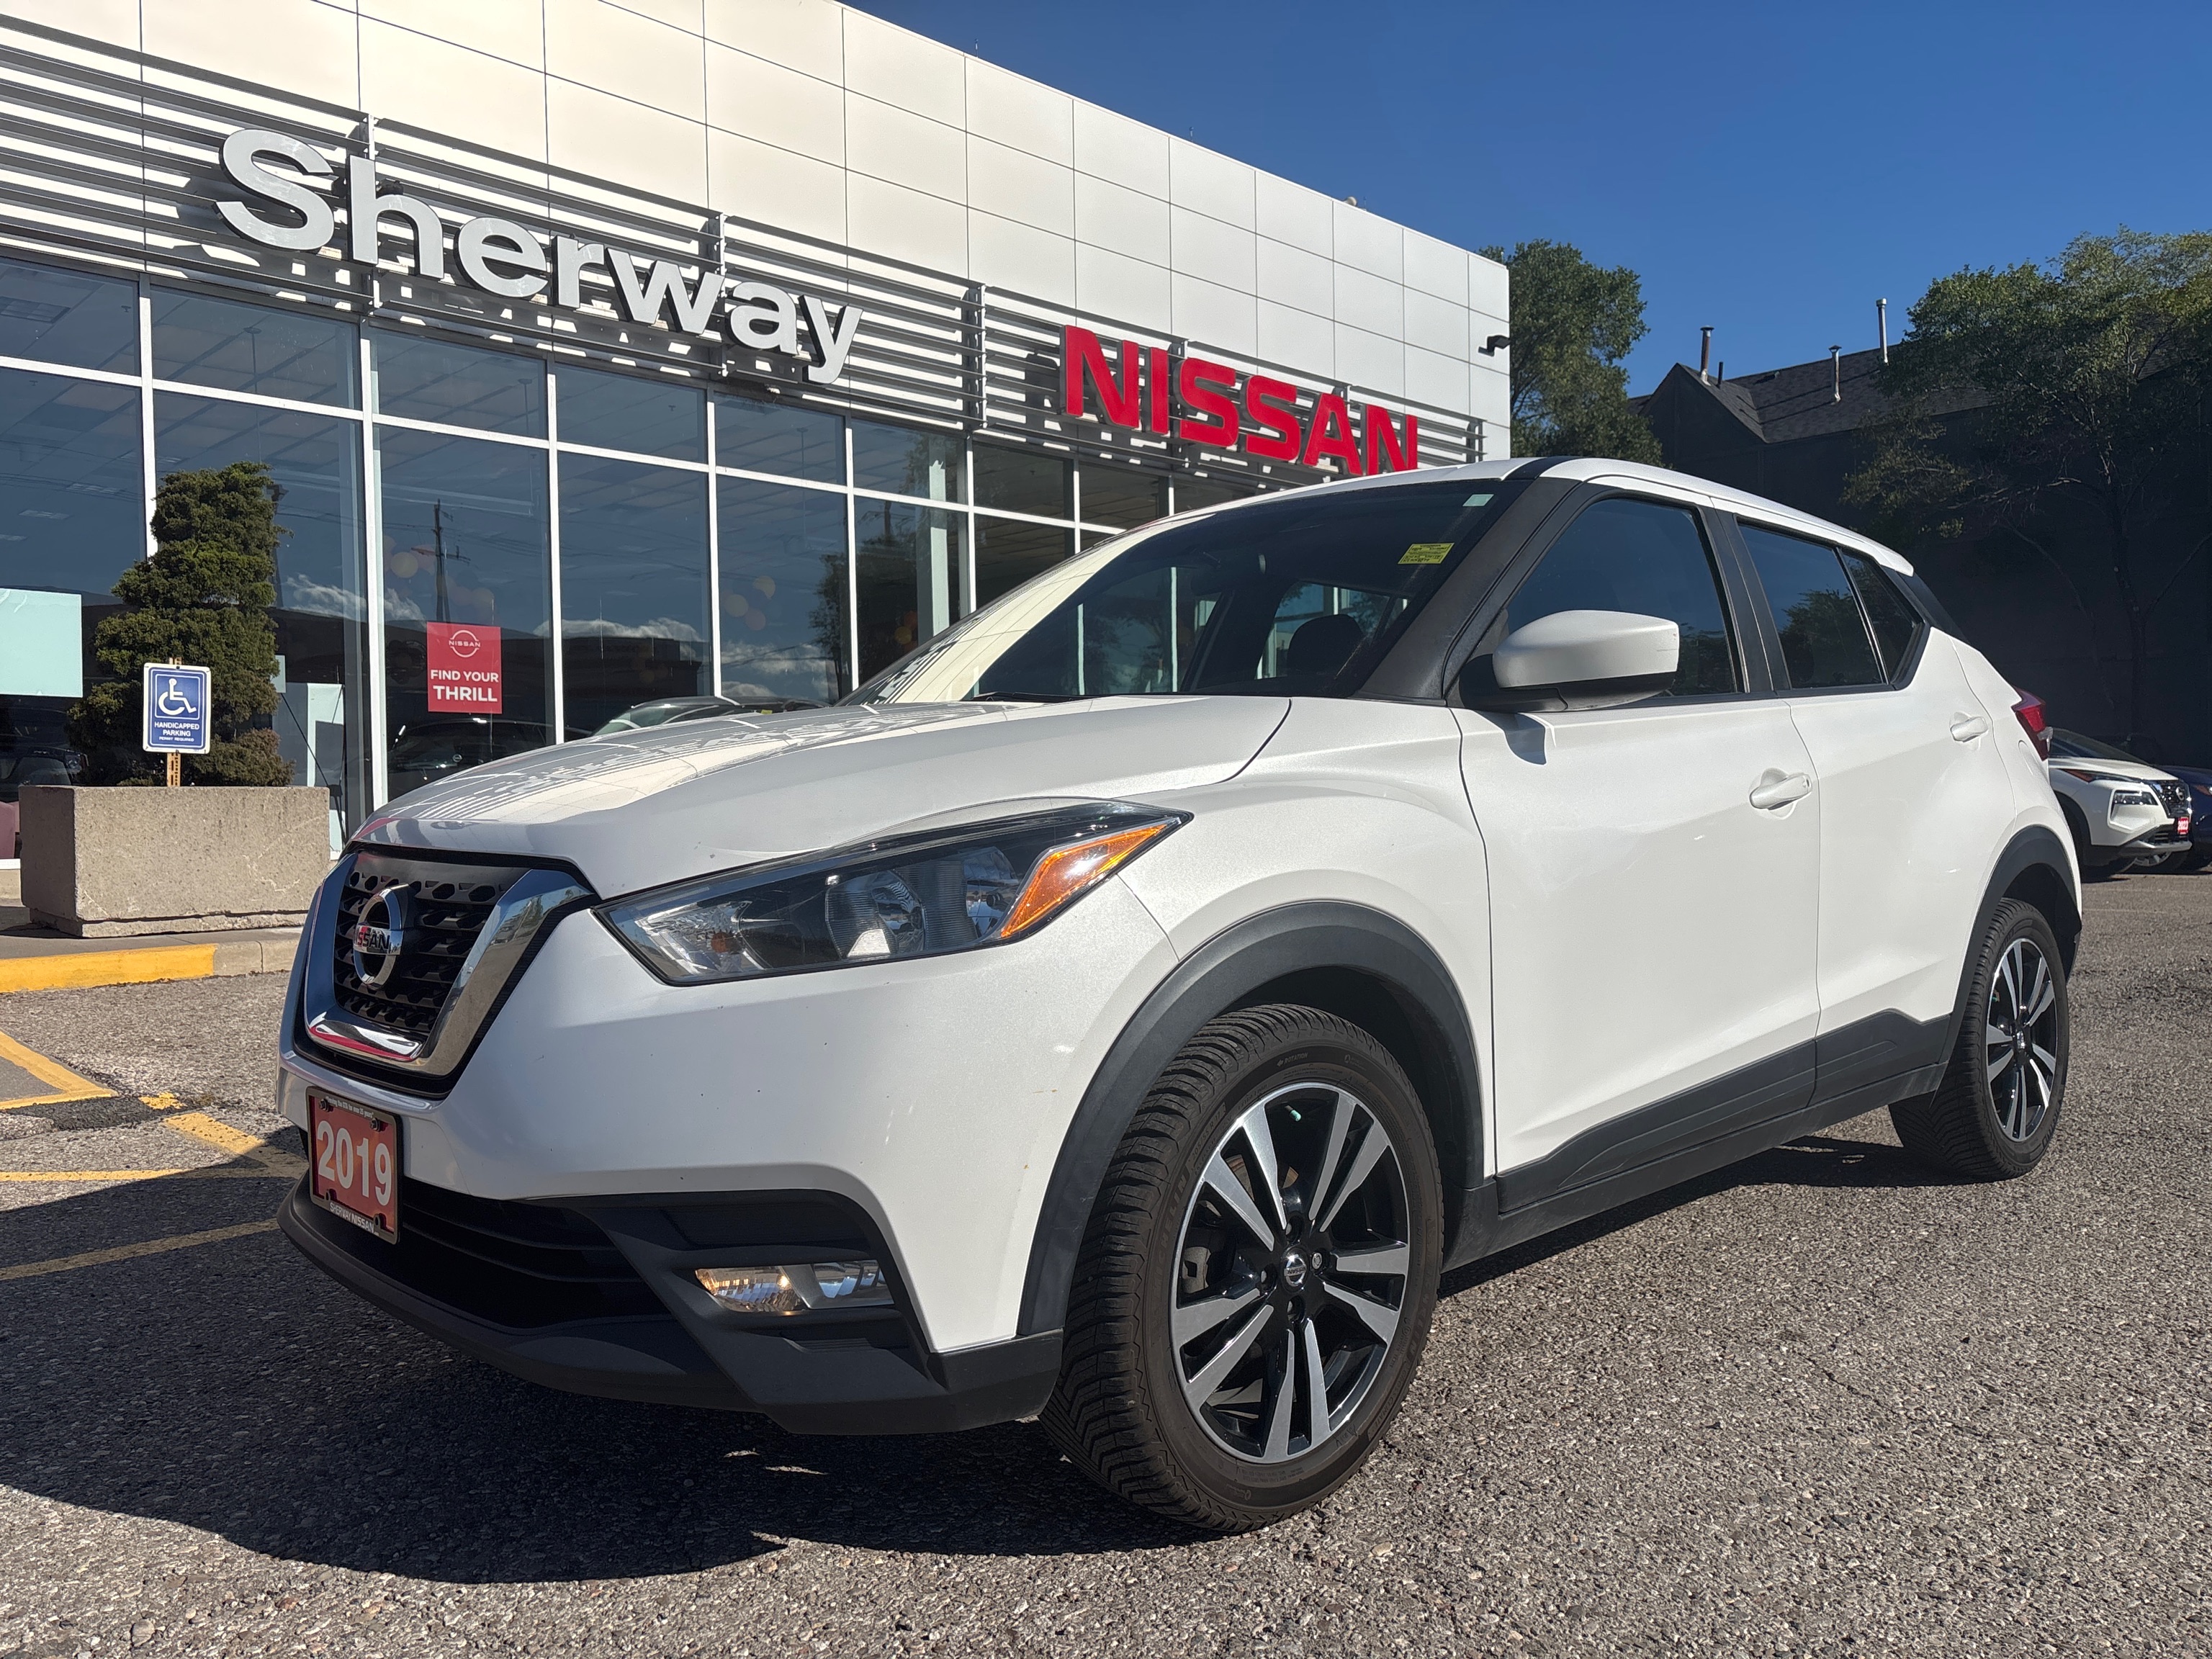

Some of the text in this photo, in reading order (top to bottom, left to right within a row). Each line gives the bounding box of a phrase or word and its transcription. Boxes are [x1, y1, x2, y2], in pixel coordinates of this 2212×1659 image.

[215, 128, 863, 383] Sherway
[1062, 325, 1418, 475] NISSAN
[430, 670, 499, 683] FIND YOUR
[433, 685, 498, 702] THRILL
[154, 721, 199, 729] HANDICAPPED
[1284, 1052, 1308, 1064] ROTATION
[317, 1120, 392, 1207] 2019
[1154, 1173, 1187, 1297] MICHELIN
